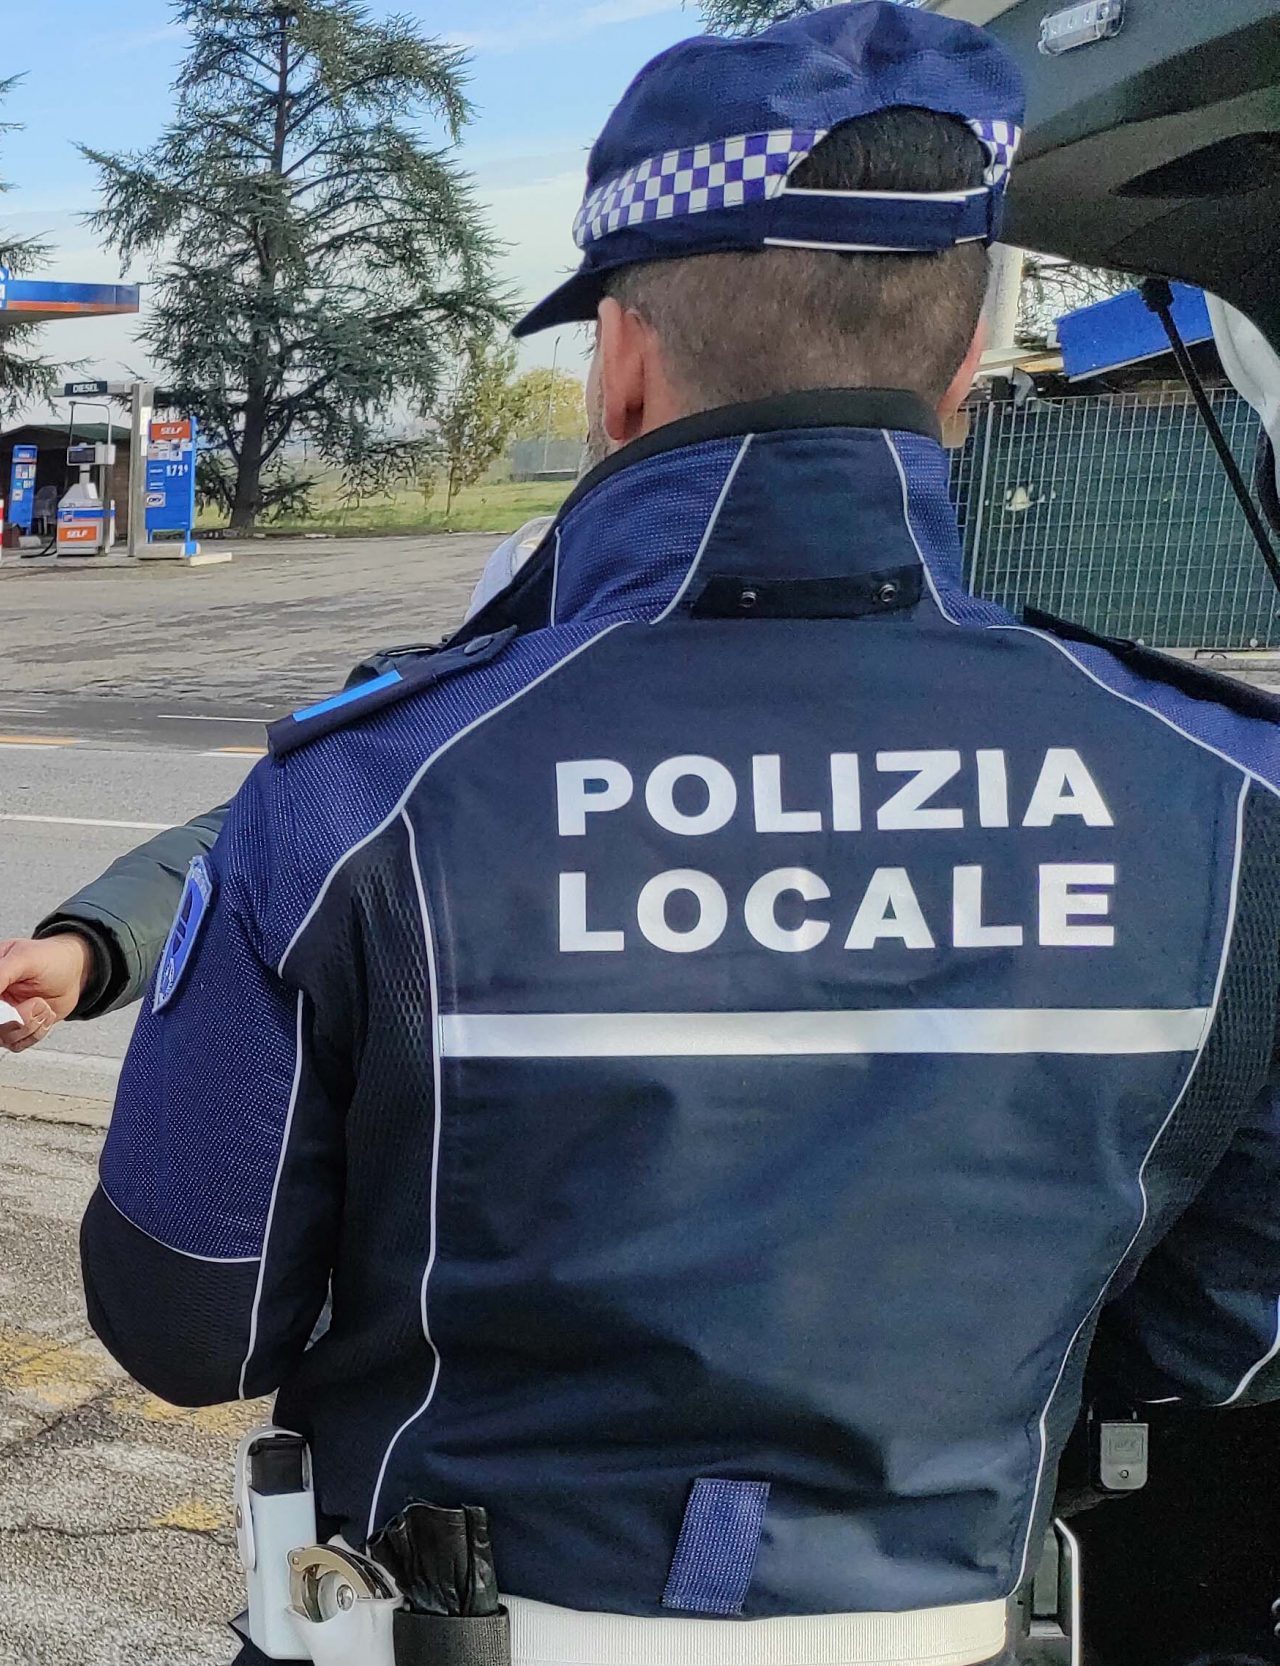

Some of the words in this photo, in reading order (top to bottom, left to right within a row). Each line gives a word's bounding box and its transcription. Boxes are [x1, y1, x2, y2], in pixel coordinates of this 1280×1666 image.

[72, 383, 99, 394] DIESEL
[160, 426, 182, 435] SELF
[66, 530, 89, 539] SELF
[555, 747, 1115, 837] POLIZIA
[558, 863, 1116, 953] LOCALE
